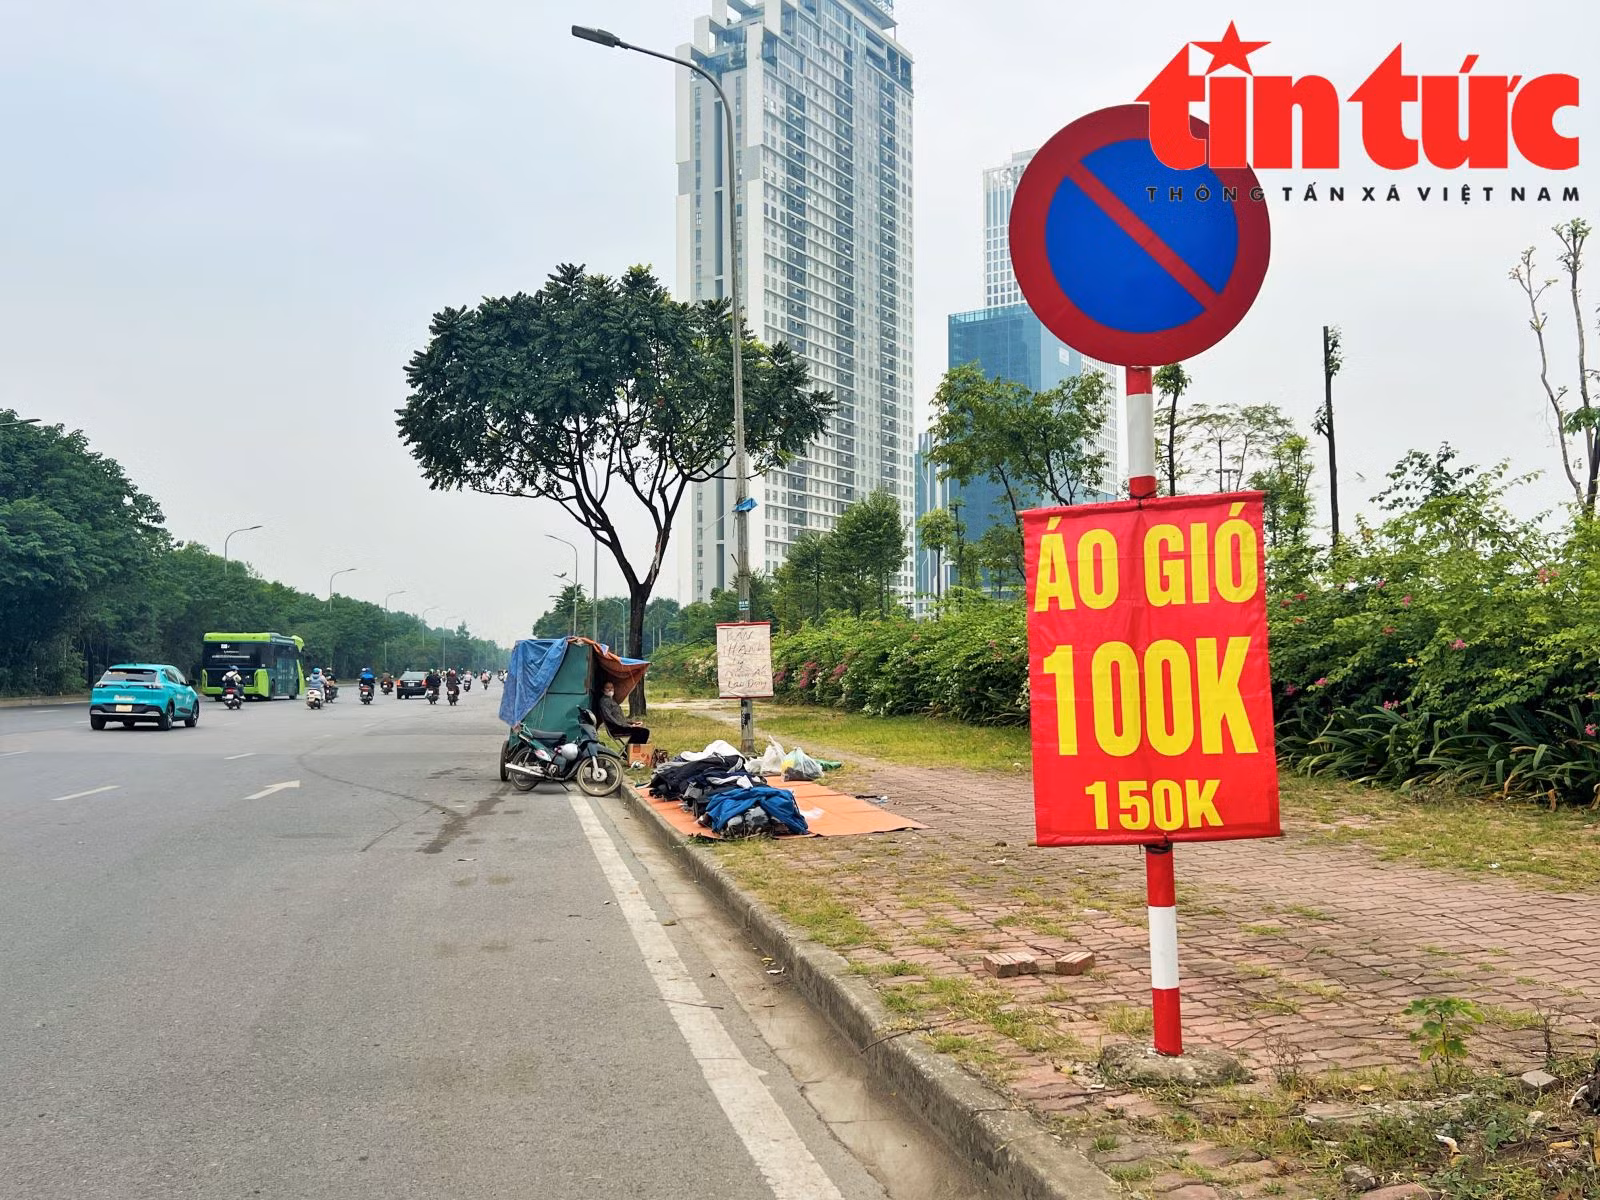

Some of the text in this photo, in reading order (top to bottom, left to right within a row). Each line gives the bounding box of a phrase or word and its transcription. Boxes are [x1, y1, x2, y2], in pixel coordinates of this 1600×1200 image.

[1034, 503, 1259, 612] ÁO GIÓ
[1043, 636, 1259, 757] 100K
[1085, 779, 1224, 832] 150K
